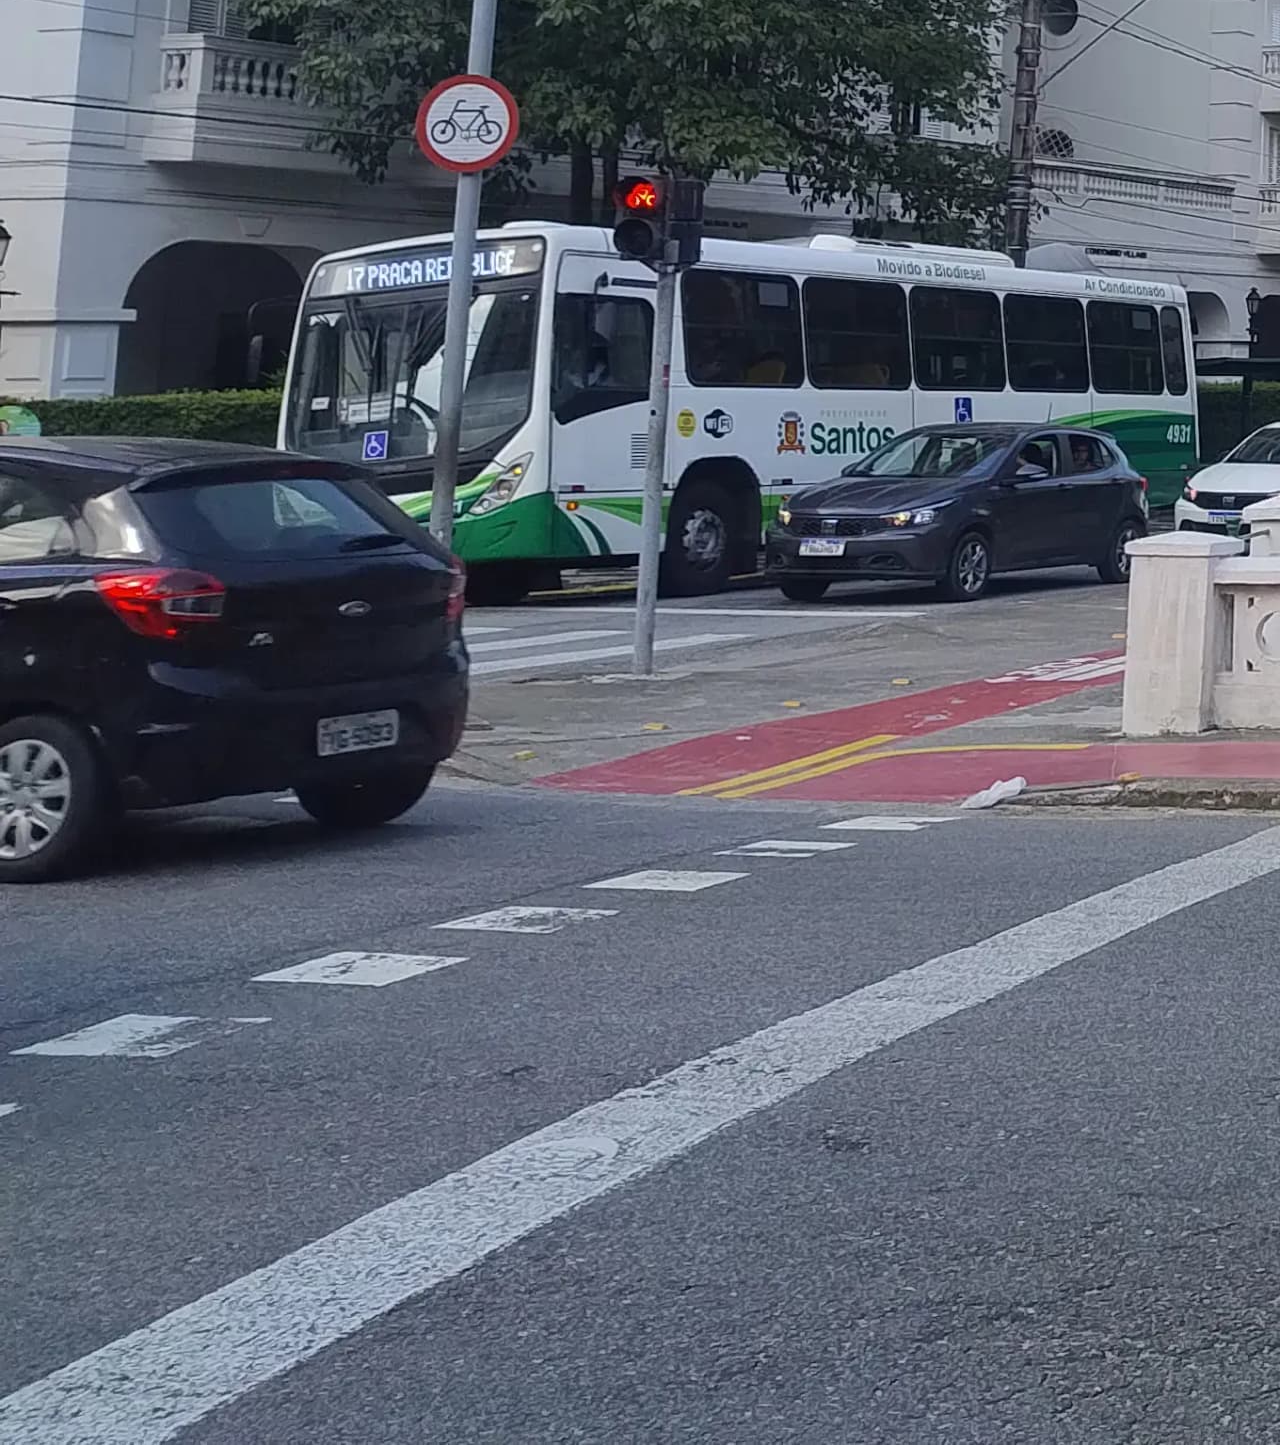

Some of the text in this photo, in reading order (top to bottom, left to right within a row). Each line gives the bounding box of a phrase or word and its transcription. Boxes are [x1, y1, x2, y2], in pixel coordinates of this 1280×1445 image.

[347, 267, 364, 291] 17
[367, 261, 422, 289] PRACA
[877, 258, 985, 281] Movido a Biodiesel
[1084, 279, 1166, 298] Ar Condicionado
[810, 420, 895, 455] Santos
[1166, 424, 1191, 444] 4931
